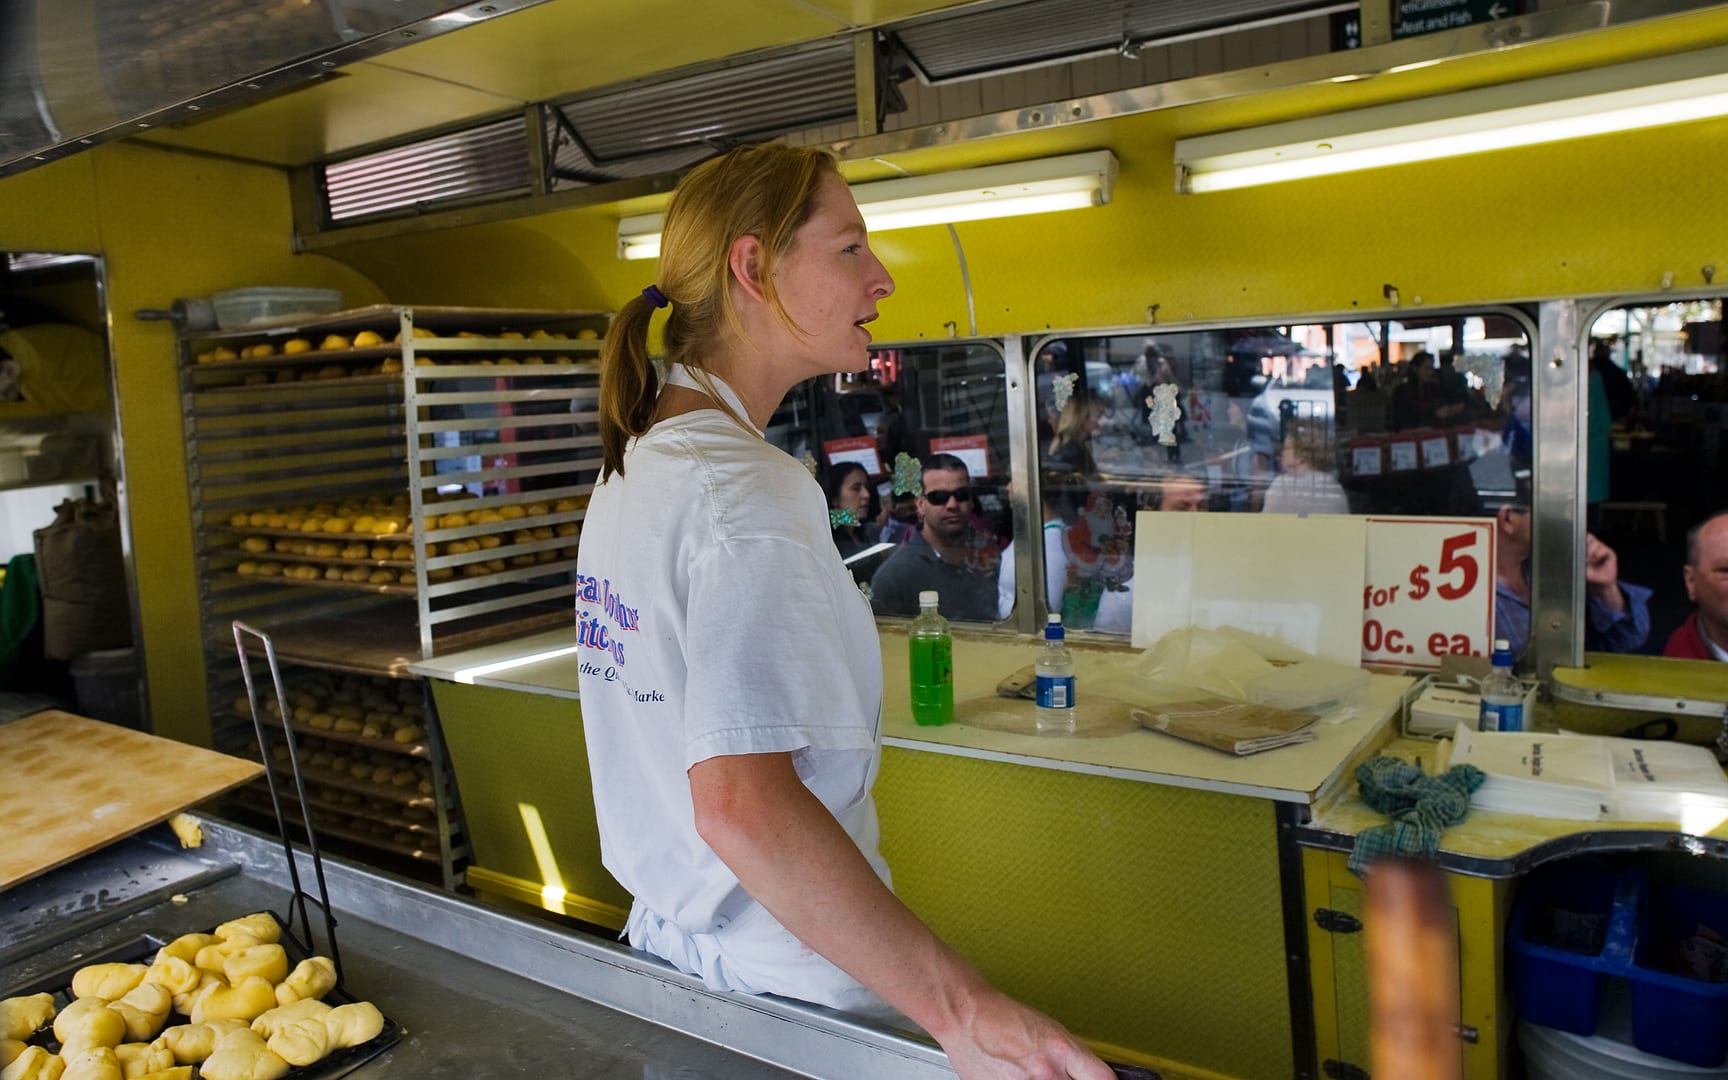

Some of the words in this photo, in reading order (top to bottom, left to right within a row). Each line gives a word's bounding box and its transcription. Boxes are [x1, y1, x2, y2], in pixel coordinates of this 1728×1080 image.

[1426, 13, 1448, 30] and
[1448, 9, 1473, 26] Fish
[1363, 584, 1400, 610] for
[1363, 619, 1414, 654] 0c.
[1427, 632, 1481, 657] ea.
[579, 662, 601, 676] the
